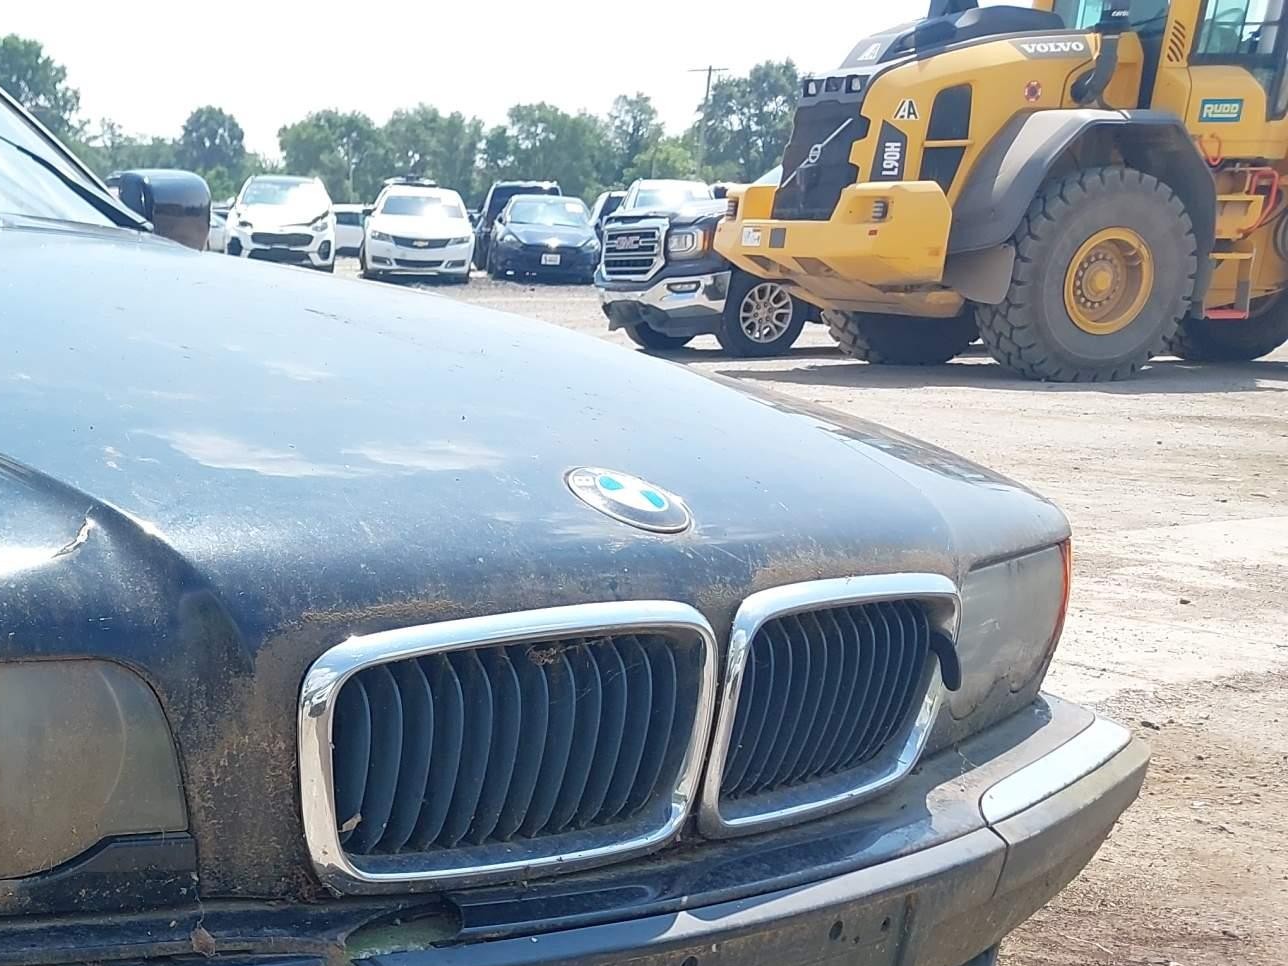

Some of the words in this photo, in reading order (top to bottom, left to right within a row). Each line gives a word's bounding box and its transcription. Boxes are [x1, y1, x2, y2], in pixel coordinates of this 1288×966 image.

[1020, 41, 1084, 53] VOLVO
[1202, 103, 1240, 118] RUDD
[881, 142, 901, 176] L90H
